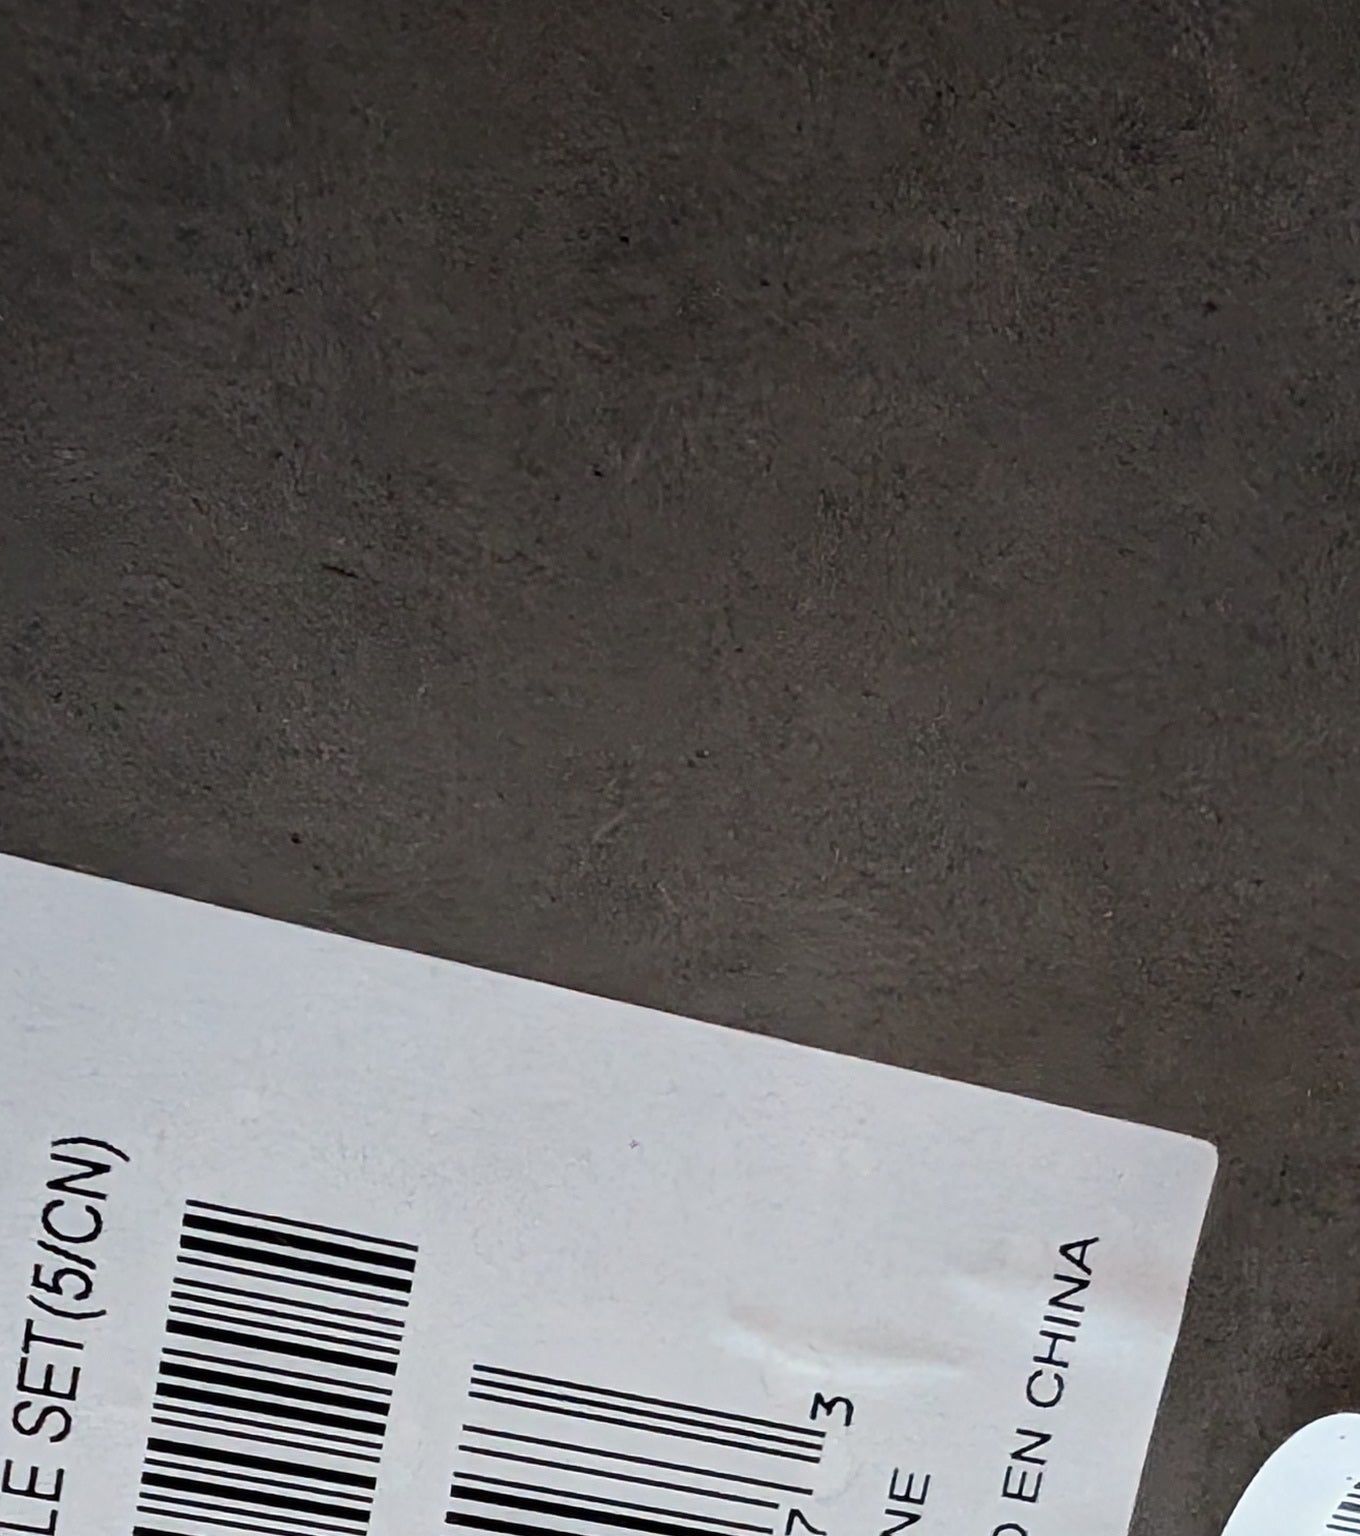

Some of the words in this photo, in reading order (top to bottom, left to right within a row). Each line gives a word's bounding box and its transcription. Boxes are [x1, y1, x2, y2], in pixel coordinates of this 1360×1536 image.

[12, 1134, 131, 1444] SET(5/CN)
[1026, 1235, 1101, 1409] CHINA
[810, 1391, 856, 1428] 3
[1002, 1426, 1052, 1501] EN
